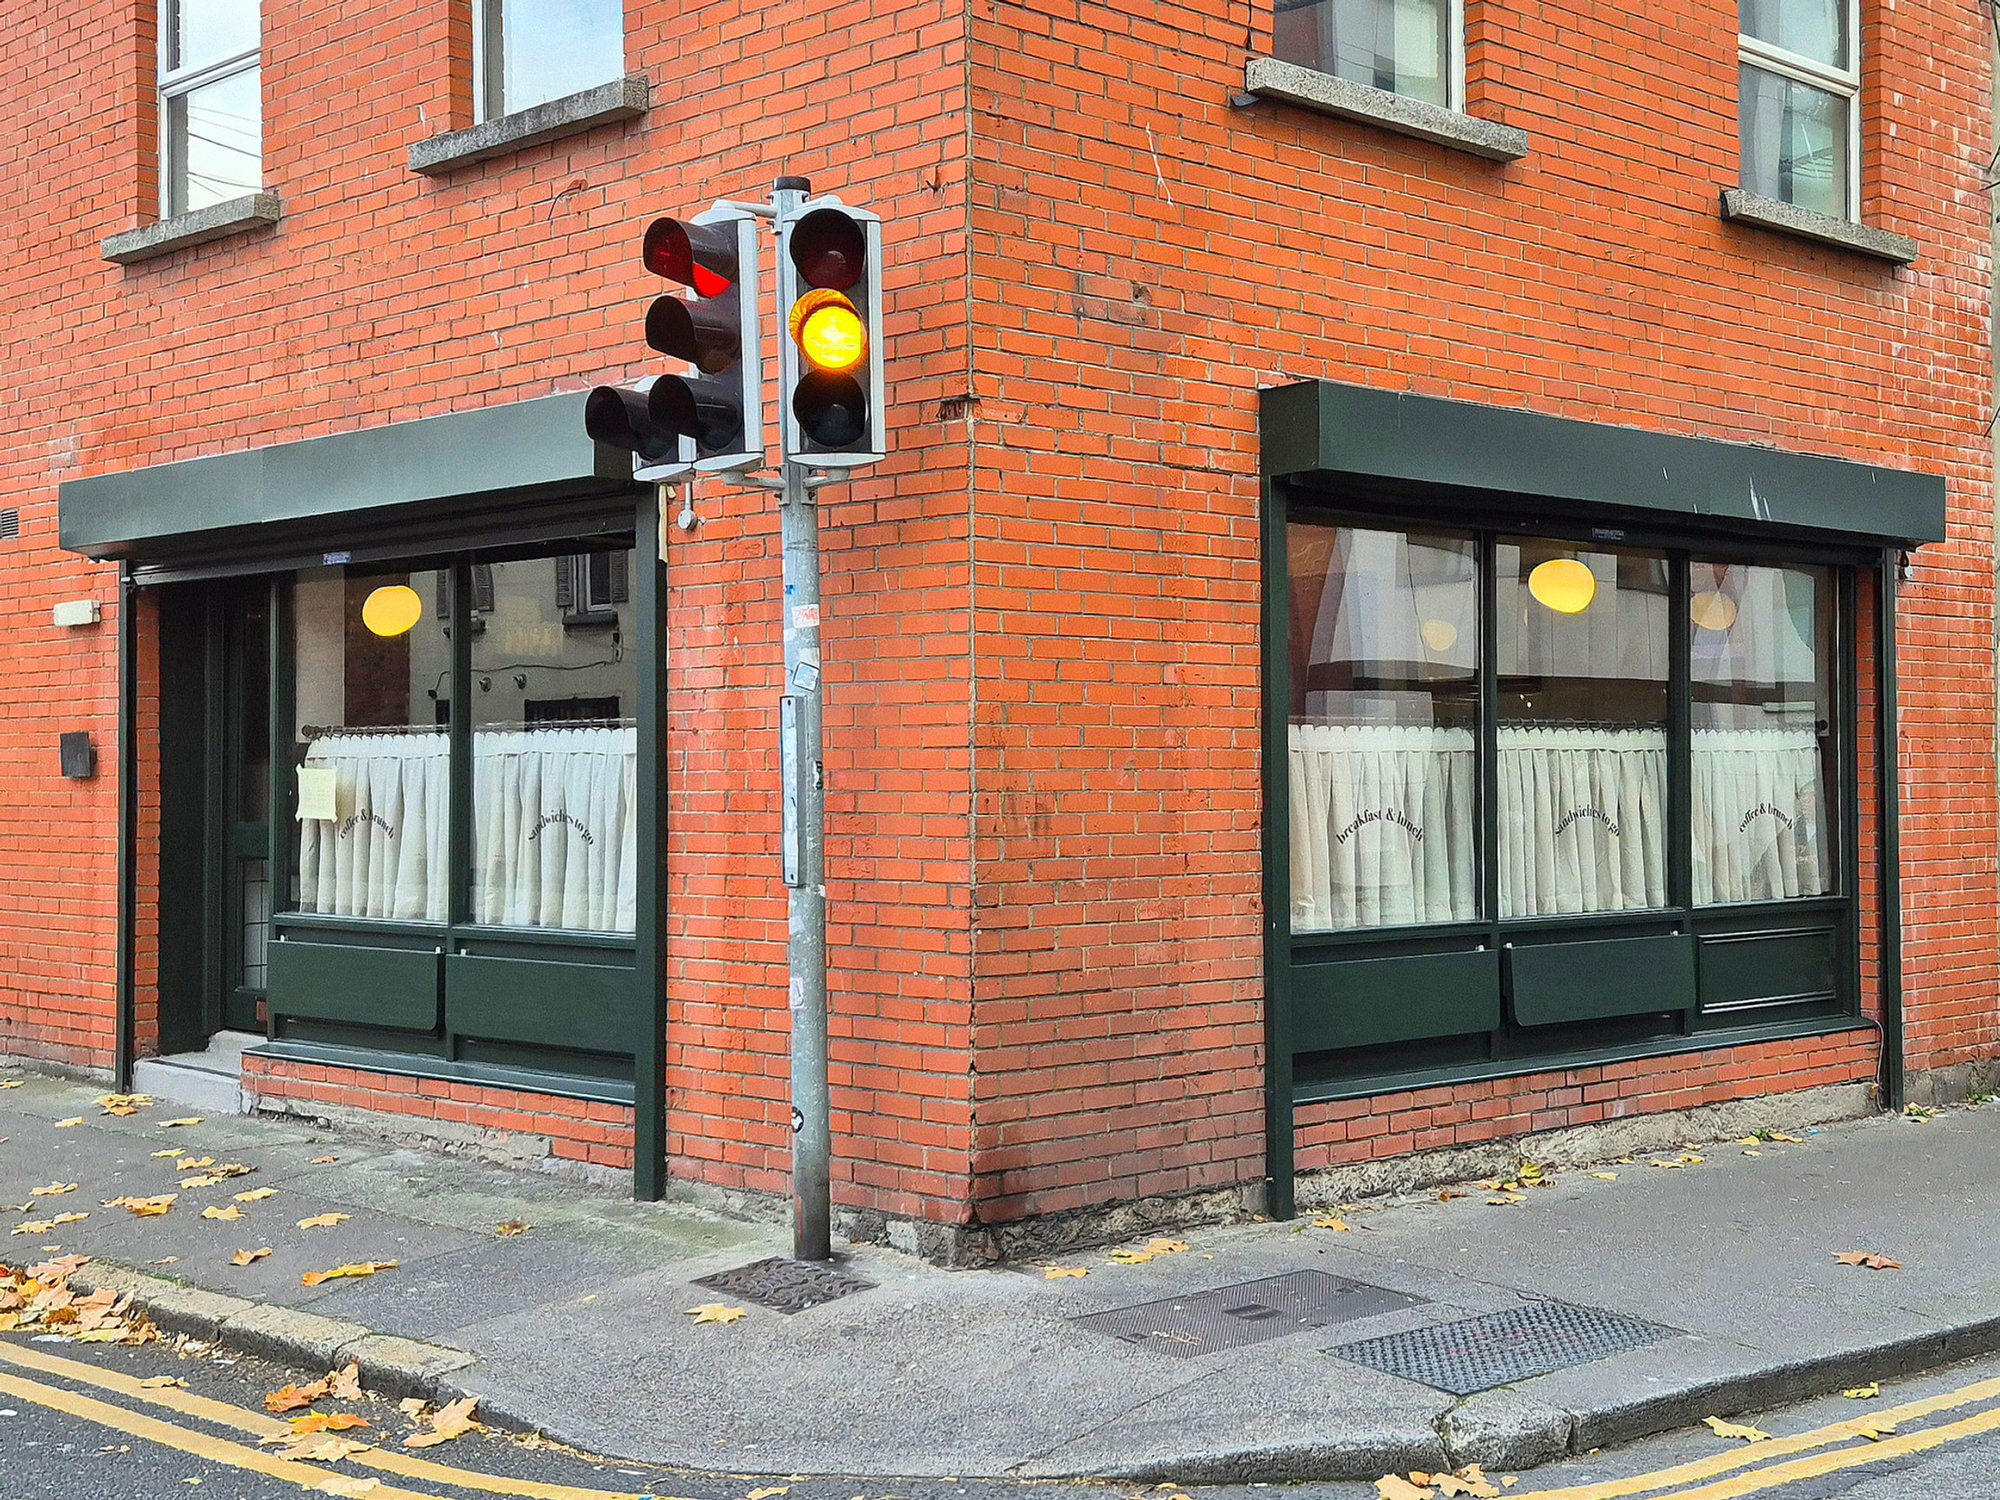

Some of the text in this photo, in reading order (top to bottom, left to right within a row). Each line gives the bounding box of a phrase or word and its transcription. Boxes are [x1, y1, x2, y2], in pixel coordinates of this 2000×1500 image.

[340, 808, 394, 839] coffee & brunch
[528, 809, 594, 845] sandwiches to go
[1336, 807, 1423, 844] breakfast & lunch
[1555, 804, 1620, 837] sandwiches to go
[1739, 802, 1793, 832] coffee & brunch
